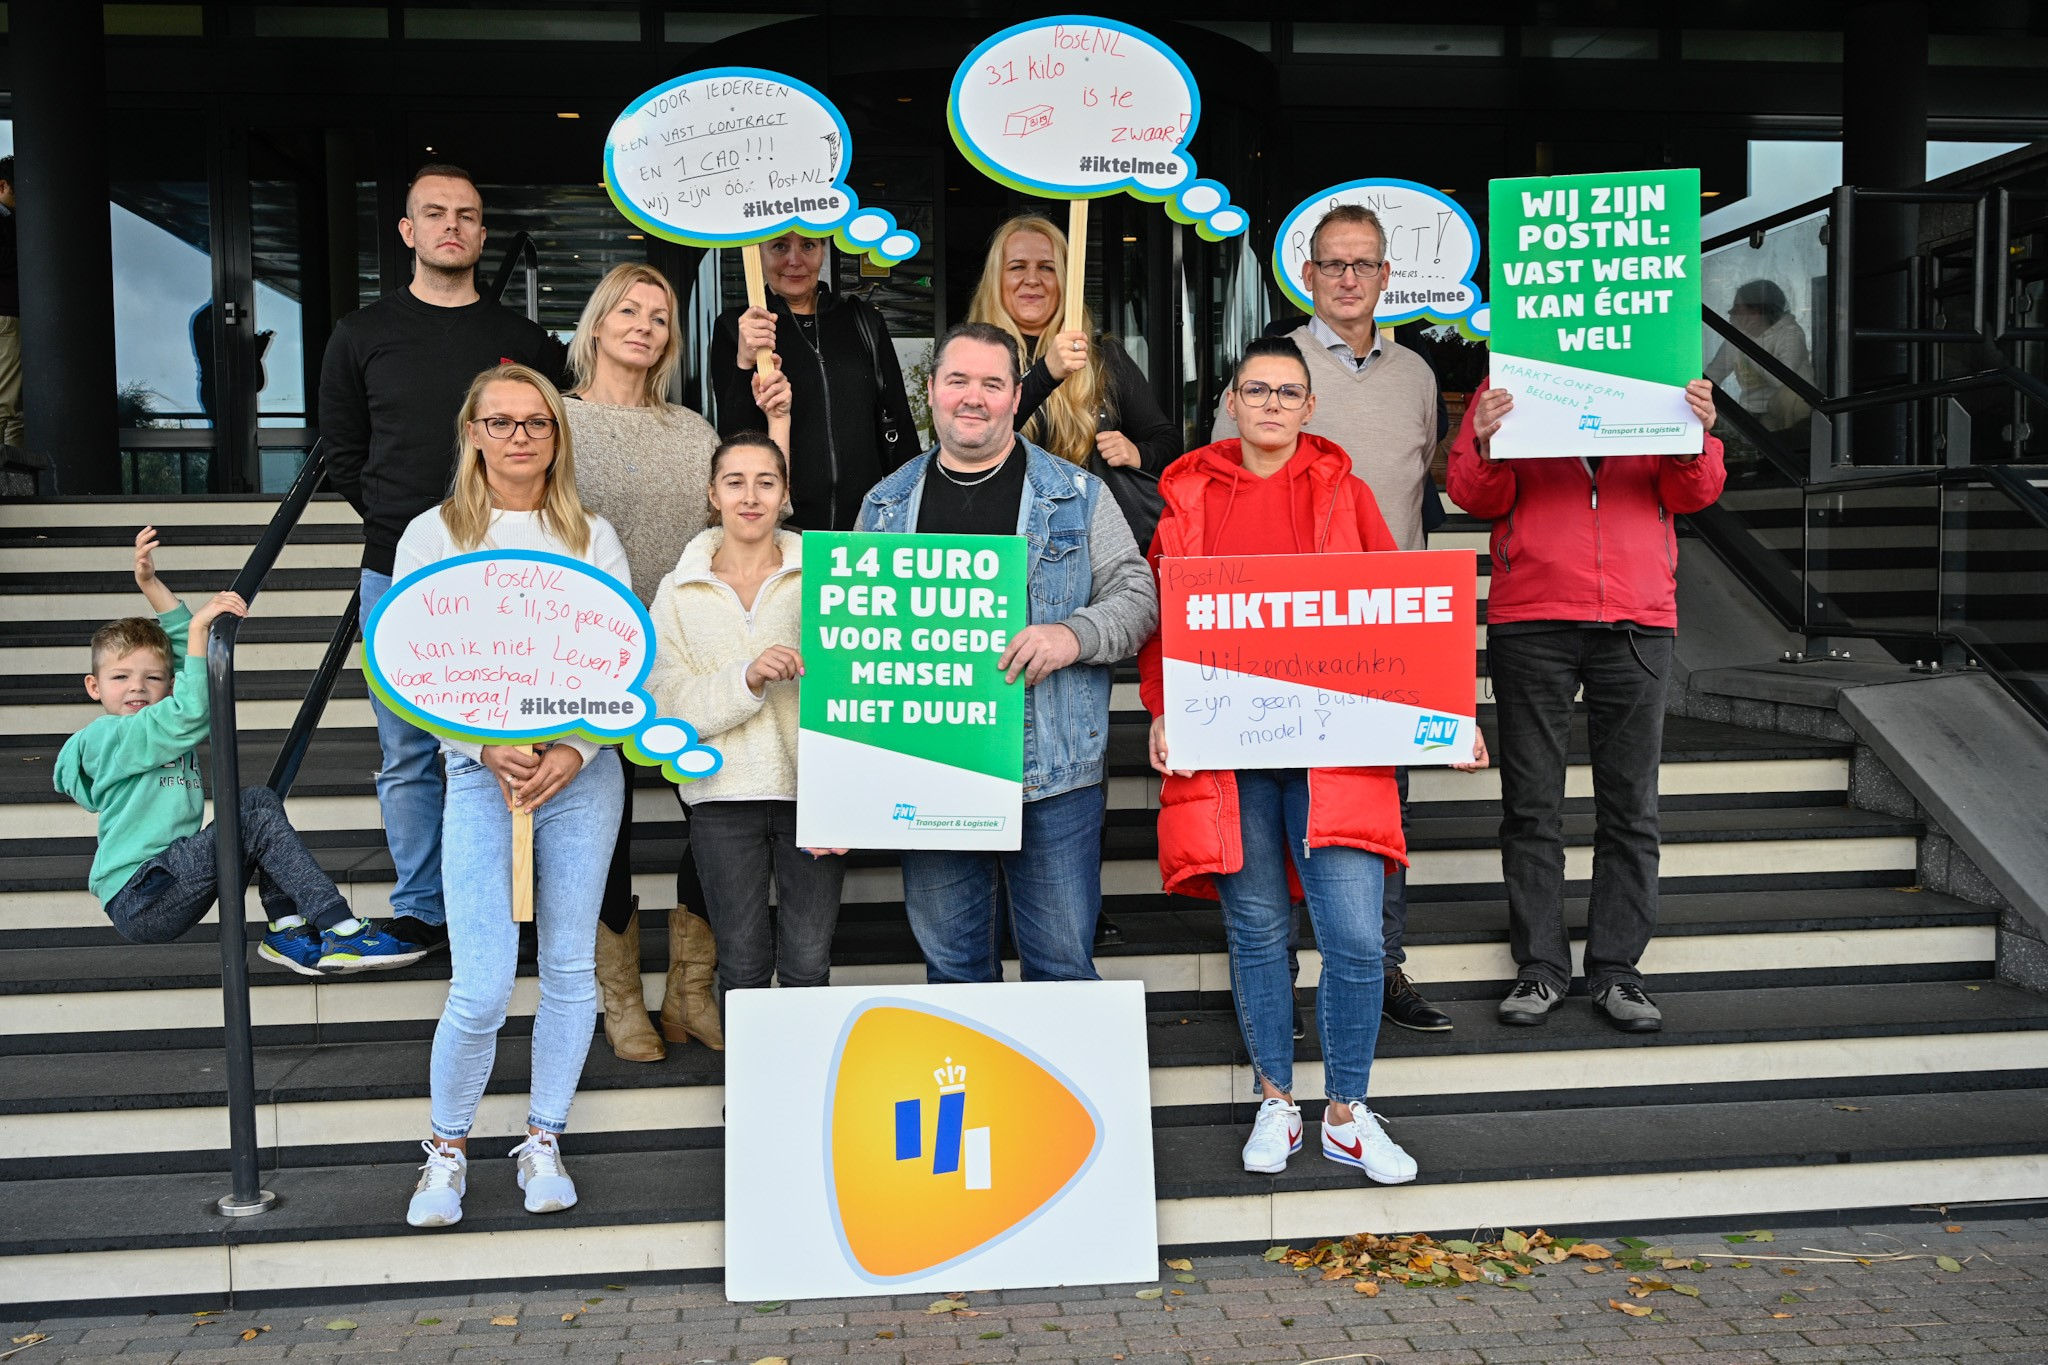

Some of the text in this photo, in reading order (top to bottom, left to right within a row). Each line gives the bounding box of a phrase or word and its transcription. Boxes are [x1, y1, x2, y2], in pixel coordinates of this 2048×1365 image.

[986, 60, 1019, 86] 31
[644, 80, 789, 118] VOOR IEDEREEN
[1083, 86, 1134, 108] is te
[660, 125, 694, 143] VAST
[708, 112, 788, 134] CONTRACT
[639, 166, 662, 181] EN
[673, 156, 687, 176] 1
[1080, 156, 1178, 175] #iktelmee
[743, 196, 840, 218] #iktelmee
[1521, 184, 1666, 222] WIJ ZIJN
[1518, 219, 1670, 252] POSTNL:
[1503, 254, 1687, 286] VAST WERK
[1384, 290, 1466, 305] #iktelmee
[1517, 287, 1673, 319] KAN ÉCHT
[1557, 324, 1632, 352] WEL!
[1579, 416, 1601, 429] FNV
[1601, 428, 1637, 436] Transport
[1646, 426, 1681, 436] Logistiek
[830, 547, 999, 580] 14 EURO
[484, 562, 565, 592] PostNL
[497, 596, 513, 614] €
[820, 585, 1008, 618] PER UUR:
[1186, 586, 1453, 630] #IKTELMEE
[493, 637, 535, 656] niet
[819, 627, 1006, 652] VOOR GOEDE
[852, 662, 973, 686] MENSEN
[415, 686, 510, 706] minimaal
[520, 697, 634, 715] #iktelmee
[1248, 694, 1300, 721] geen
[1318, 689, 1420, 705] business
[460, 708, 509, 728] € 14
[827, 700, 997, 724] NIET DUUR!
[1416, 720, 1456, 740] FNV
[894, 805, 915, 820] FNV
[916, 819, 953, 827] Transport
[963, 820, 999, 829] Logistiek
